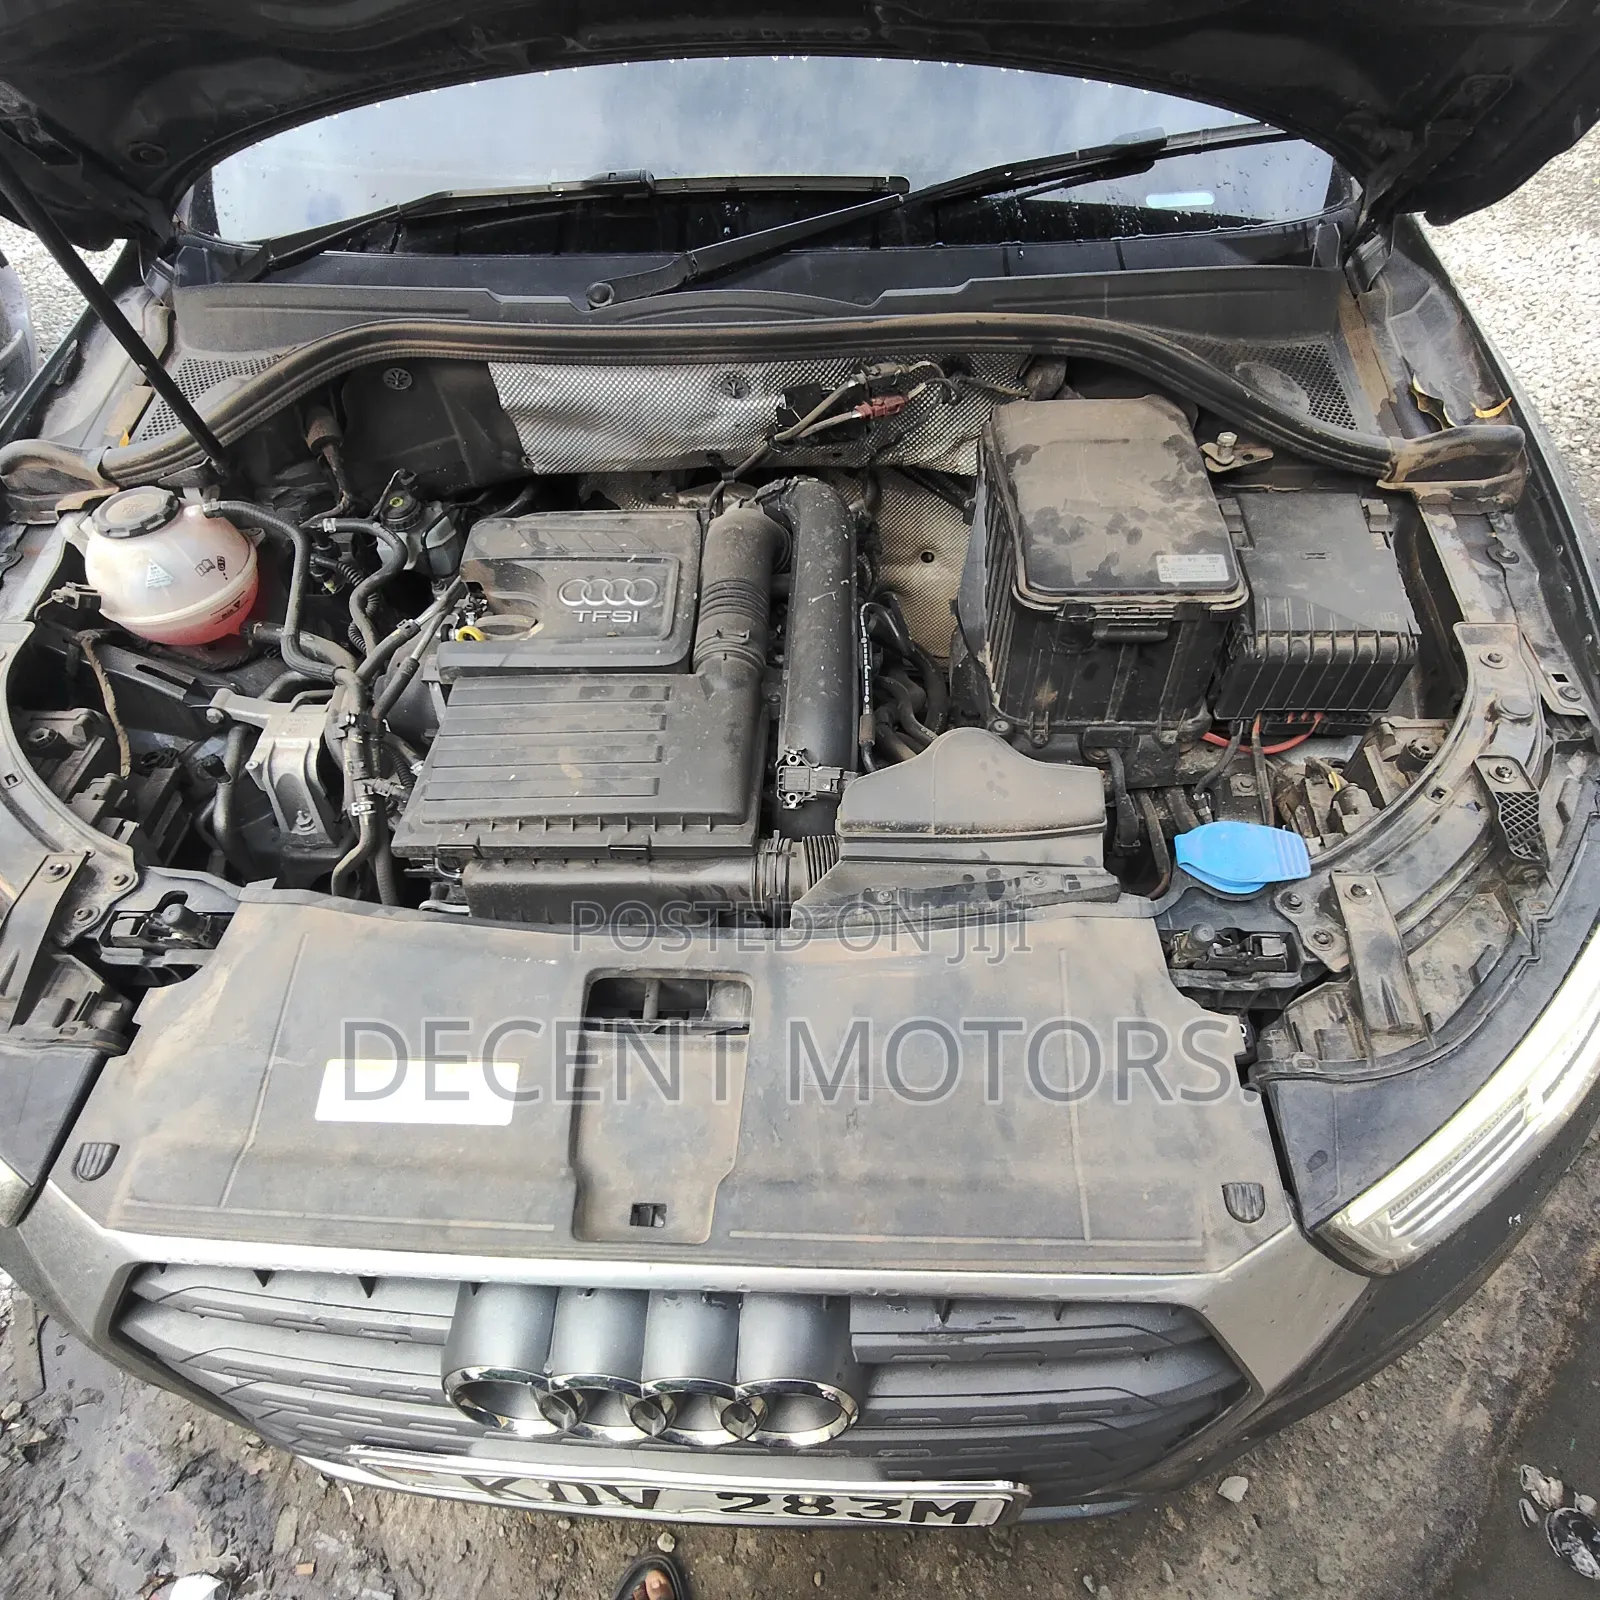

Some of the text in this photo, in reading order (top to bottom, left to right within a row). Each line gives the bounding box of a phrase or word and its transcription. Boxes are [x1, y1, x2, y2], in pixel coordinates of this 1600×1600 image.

[221, 608, 235, 619] min
[572, 610, 639, 623] TFSI
[714, 1491, 977, 1525] 283M
